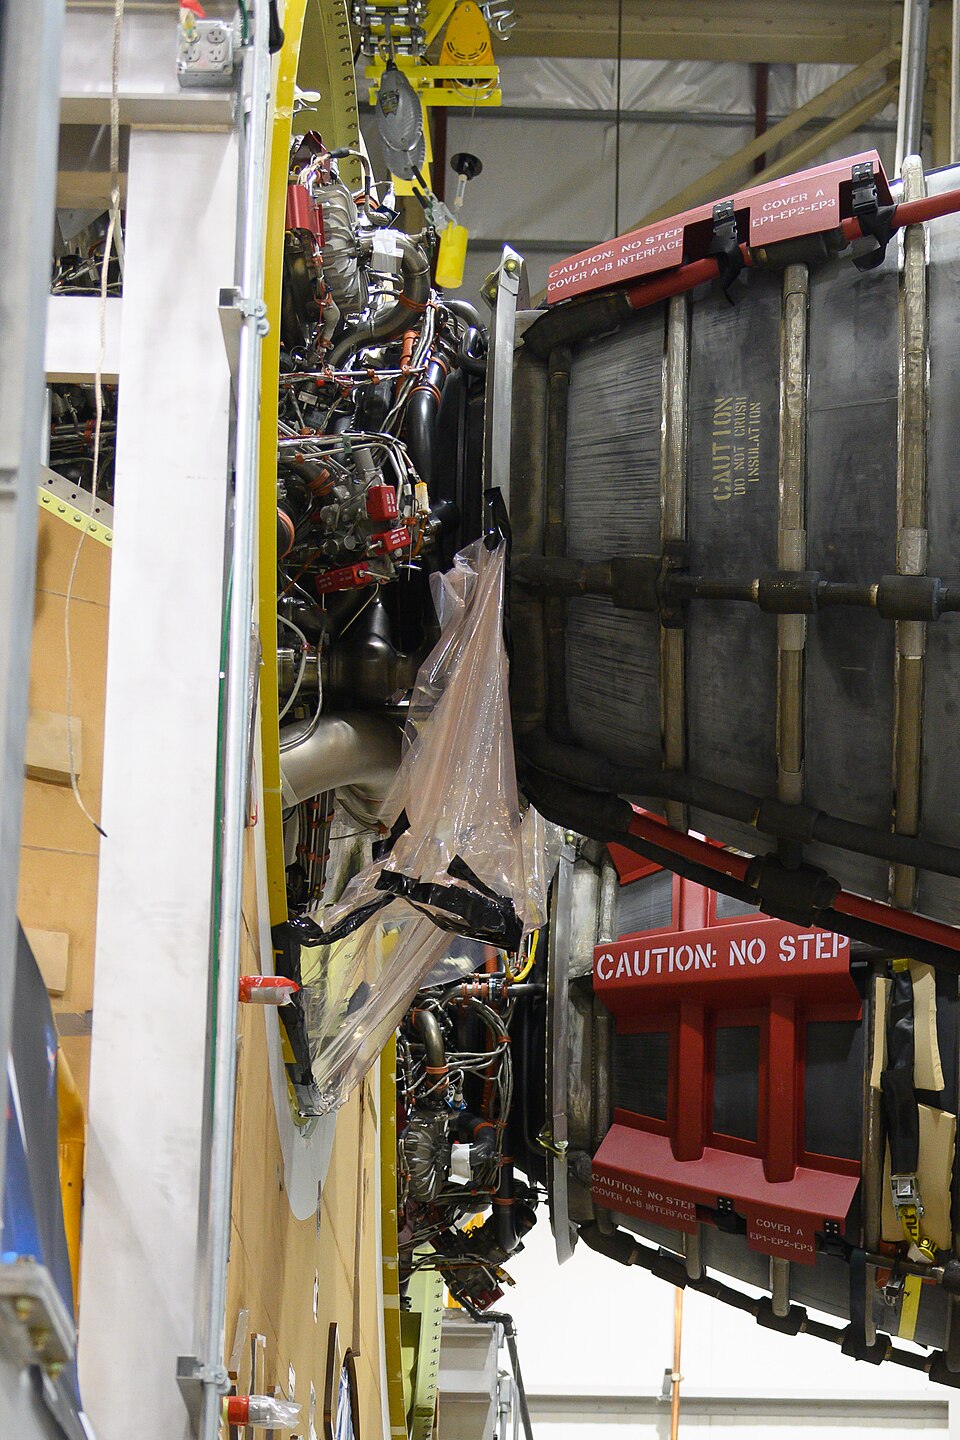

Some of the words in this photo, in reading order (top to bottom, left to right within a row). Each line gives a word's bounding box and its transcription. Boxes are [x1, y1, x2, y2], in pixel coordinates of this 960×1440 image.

[752, 197, 836, 228] EP1-EP2-EP3
[762, 191, 808, 212] COVER
[814, 188, 825, 198] A
[547, 270, 588, 292] COVER
[589, 261, 613, 279] A-B
[617, 238, 683, 272] INTERFACE
[548, 249, 615, 278] CAUTION:
[621, 239, 642, 253] NO
[645, 226, 683, 246] STEP
[734, 396, 747, 437] CRUSH
[712, 396, 733, 501] CAUTION
[733, 445, 745, 471] NOT
[748, 401, 760, 482] INSULATION
[734, 478, 746, 496] DO
[596, 942, 717, 981] CAUTION:
[729, 937, 766, 966] NO
[778, 932, 849, 963] STEP
[591, 1172, 643, 1196] CAUTION:
[647, 1189, 664, 1202] NO
[666, 1196, 696, 1210] STEP
[591, 1184, 623, 1201] COVER
[625, 1196, 643, 1208] A-B
[645, 1202, 696, 1222] INTERFACE
[749, 1231, 813, 1253] EP1-EP2-EP3
[755, 1217, 791, 1233] COVER
[796, 1228, 803, 1236] A
